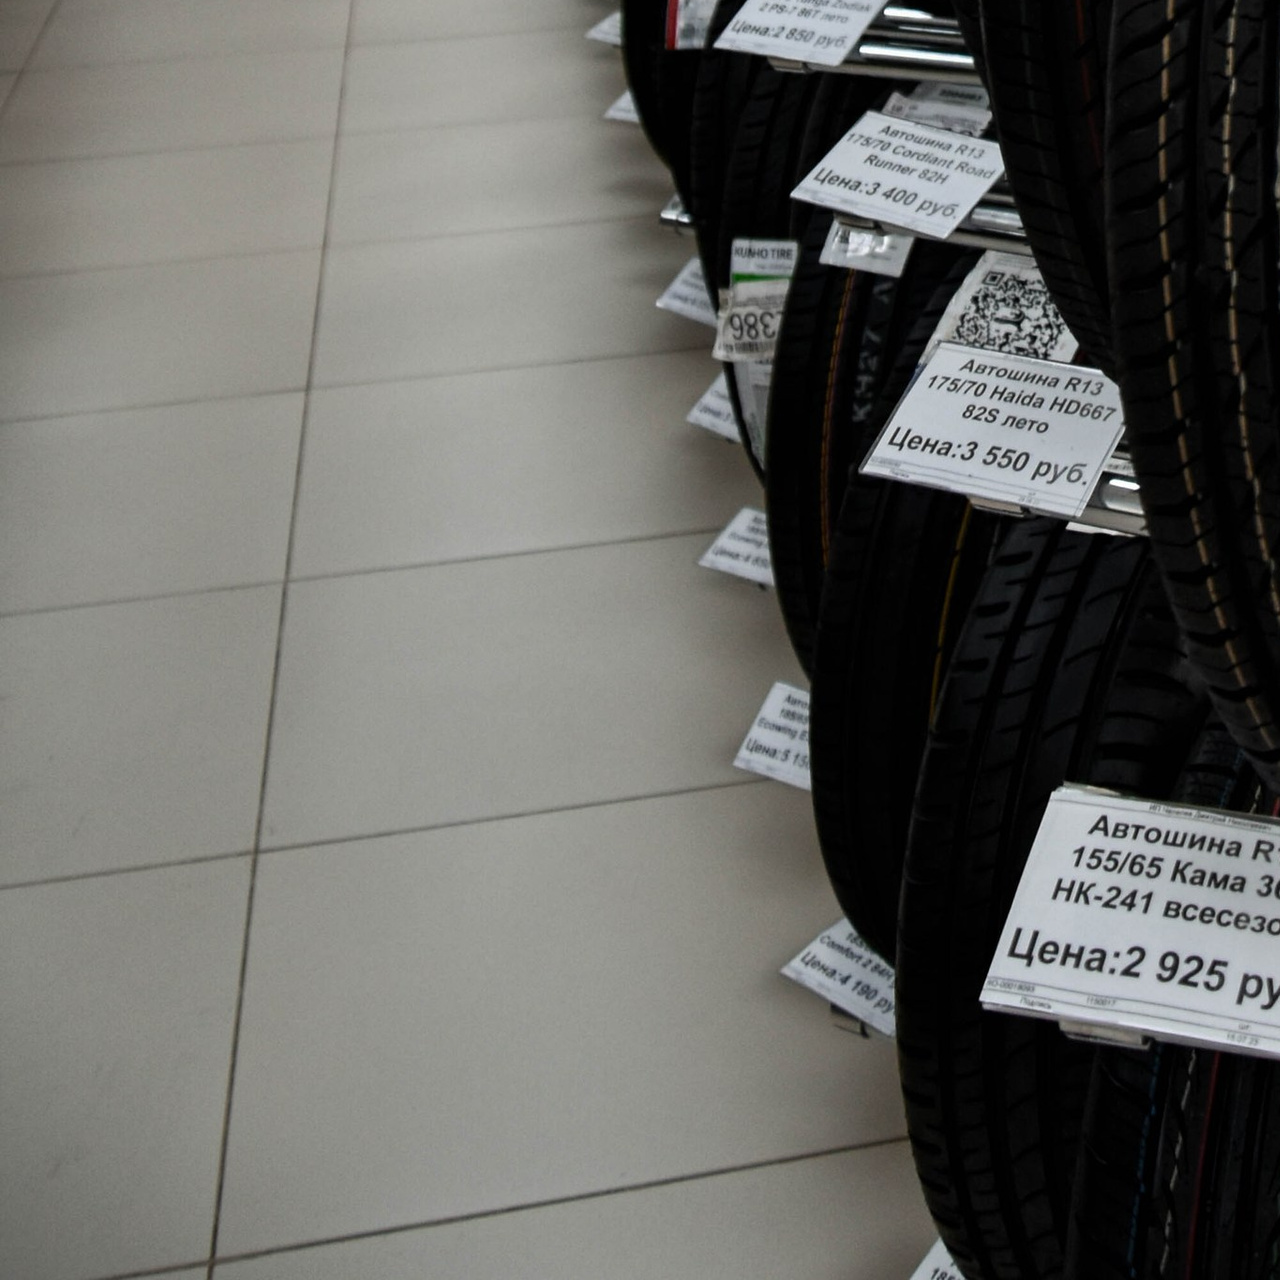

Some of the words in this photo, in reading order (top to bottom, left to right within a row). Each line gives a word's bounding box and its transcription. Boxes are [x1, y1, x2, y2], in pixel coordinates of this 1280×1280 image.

[820, 13, 850, 24] лето
[832, 0, 872, 13] Zodiak
[731, 20, 785, 39] Цена:2
[785, 27, 815, 43] 850
[814, 35, 847, 50] руб.
[847, 132, 891, 151] 175/70
[892, 145, 954, 169] Cordiant
[955, 160, 996, 180] Road
[879, 125, 952, 152] Автошина
[955, 144, 985, 160] R13
[863, 154, 919, 177] Runner
[918, 169, 949, 186] 82H
[813, 167, 881, 196] Цена:3
[882, 187, 918, 206] 400
[915, 198, 961, 220] руб.
[770, 247, 794, 260] TIRE
[959, 359, 1059, 388] Автошина
[1064, 376, 1104, 396] R13
[927, 374, 987, 397] 175/70
[989, 385, 1046, 409] Haida
[1048, 396, 1117, 422] HD667
[962, 404, 1000, 424] 82S
[1001, 414, 1049, 434] лето
[888, 426, 979, 461] Цена:3
[982, 446, 1030, 472] 550
[1031, 459, 1088, 487] руб.
[1088, 815, 1243, 858] Автошина
[1072, 846, 1164, 879] 155/65
[1170, 860, 1246, 893] Кама
[1051, 878, 1153, 915] НК-241
[820, 935, 863, 963] Comfort
[861, 959, 872, 969] 2
[1007, 927, 1147, 980] Цена:2
[1156, 951, 1228, 992] 925
[800, 951, 852, 985] Цена:4
[851, 981, 879, 1001] 190
